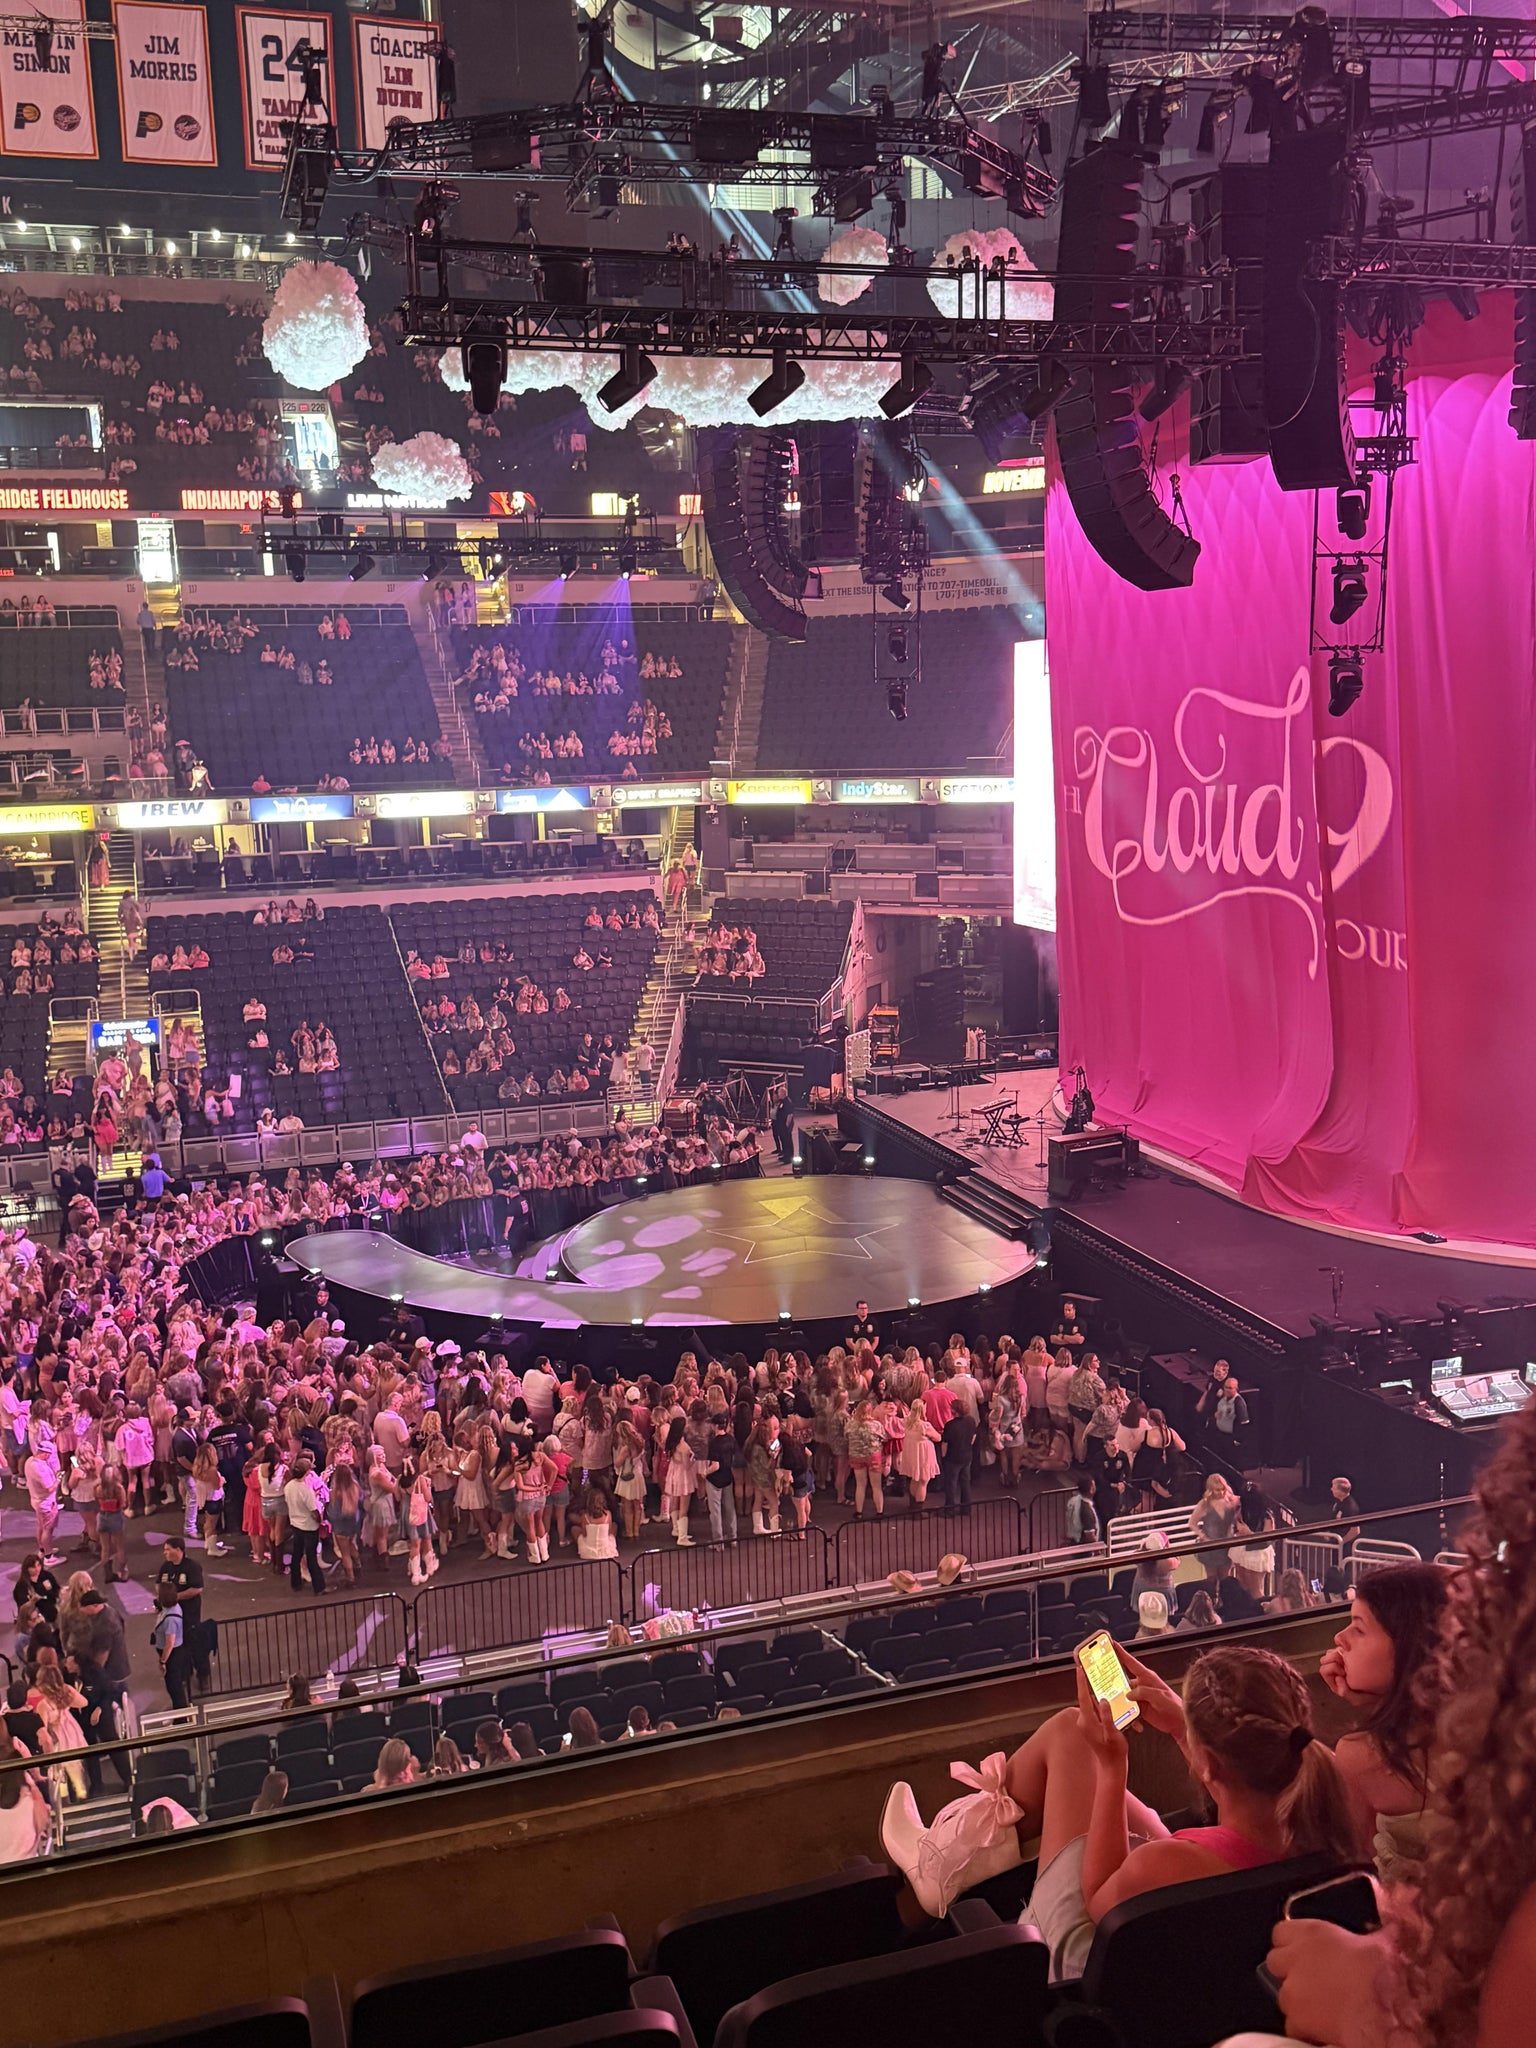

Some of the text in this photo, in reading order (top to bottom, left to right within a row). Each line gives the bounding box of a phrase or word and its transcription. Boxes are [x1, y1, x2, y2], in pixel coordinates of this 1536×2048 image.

[4, 32, 76, 50] MEIN
[144, 35, 180, 55] JIM
[370, 37, 426, 60] COACH
[261, 34, 312, 83] 24
[129, 60, 197, 82] MORRIS
[384, 66, 413, 86] LIN
[376, 88, 424, 110] DUNN
[282, 402, 297, 411] 225
[42, 488, 129, 509] FIELDHOUSE
[347, 493, 383, 508] LIVE
[837, 586, 852, 596] THE
[927, 581, 938, 590] TO
[141, 802, 205, 817] IBEW
[1074, 666, 1393, 981] Cloud 9
